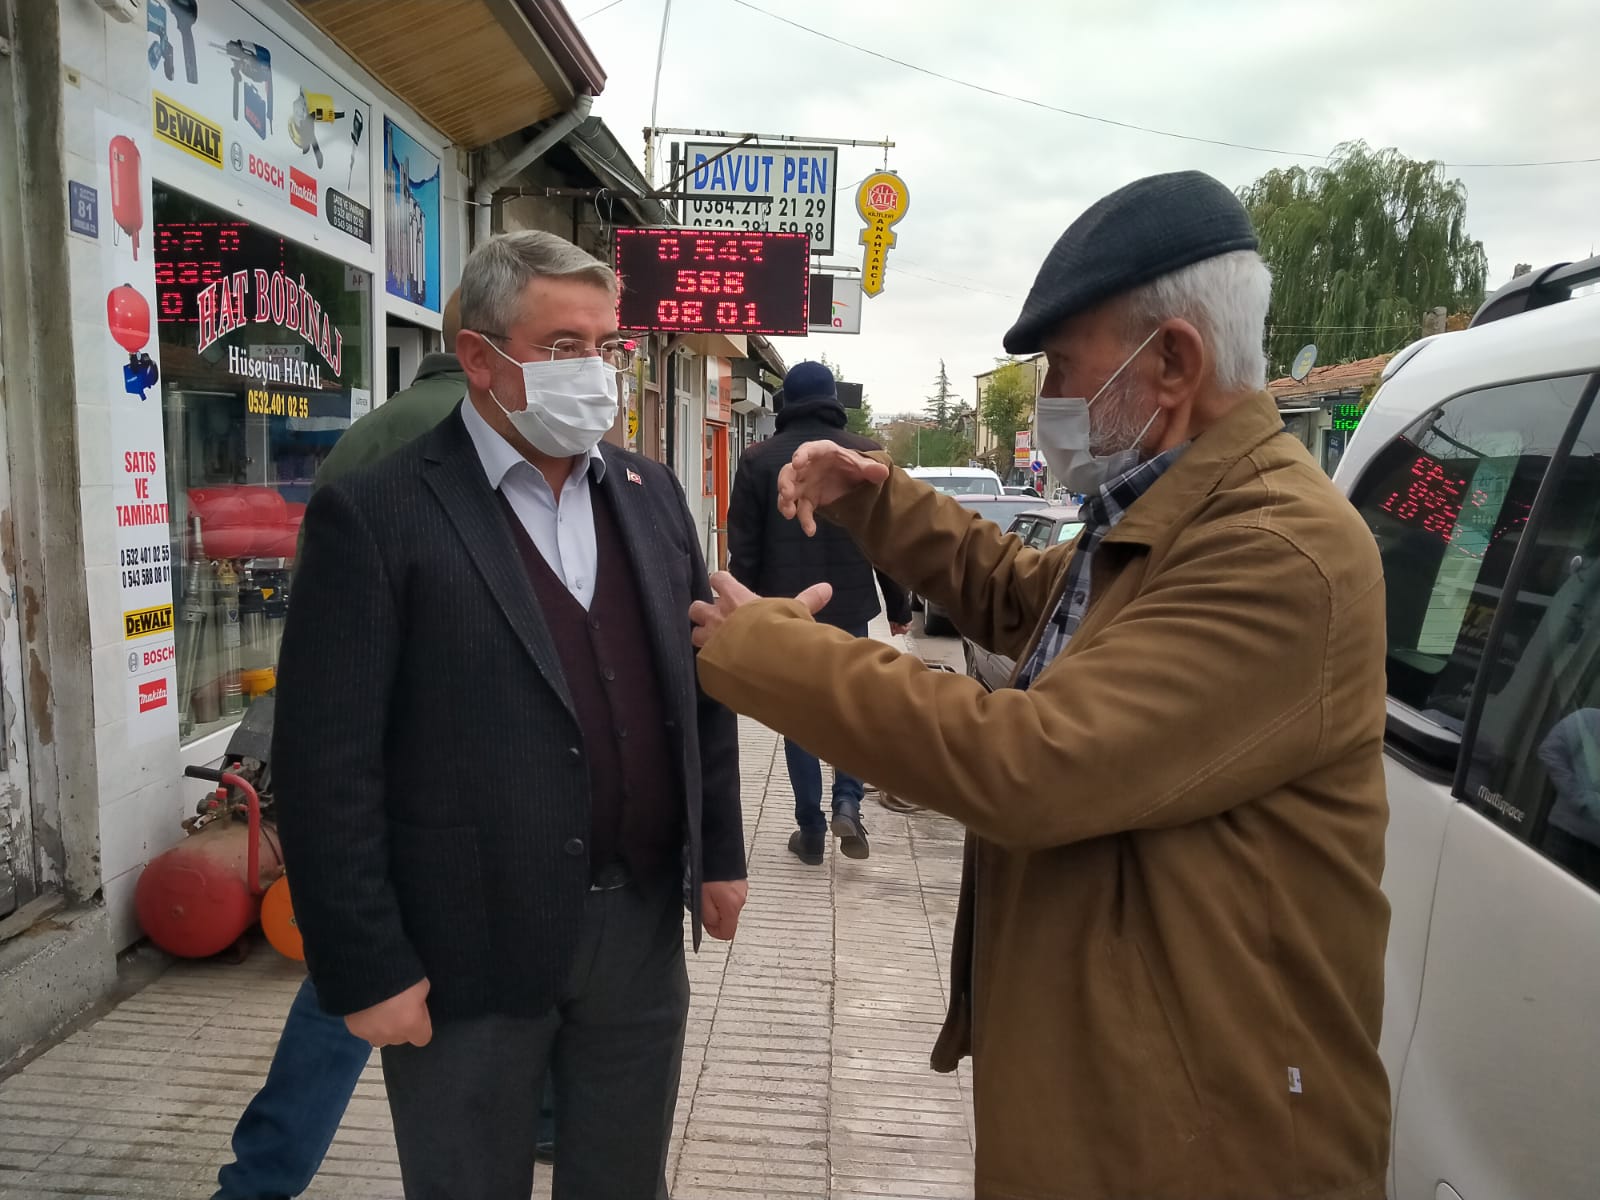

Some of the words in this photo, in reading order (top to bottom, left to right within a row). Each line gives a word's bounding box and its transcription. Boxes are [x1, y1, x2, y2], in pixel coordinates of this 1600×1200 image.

[249, 153, 285, 190] BOSCH
[694, 153, 774, 193] DAVUT
[783, 156, 828, 195] PEN
[78, 200, 93, 221] 81
[779, 197, 797, 217] 21
[804, 198, 826, 218] 29
[867, 187, 897, 210] KALE
[870, 218, 884, 286] ANAHTARCI
[675, 270, 745, 294] 588
[197, 269, 248, 355] HAT
[254, 268, 343, 378] BOBİNAJ
[657, 300, 703, 323] 08
[716, 301, 761, 325] 01
[228, 345, 280, 386] Hüseyin
[284, 357, 323, 390] HATAL
[287, 395, 297, 417] 02
[299, 397, 309, 419] 55
[125, 451, 156, 475] SATIŞ
[135, 478, 149, 499] VE
[121, 549, 125, 567] 0
[126, 548, 139, 566] 532
[140, 546, 151, 564] 401
[153, 545, 161, 562] 02
[161, 544, 169, 562] 55
[122, 571, 127, 588] 0
[128, 569, 140, 588] 543
[141, 567, 153, 586] 588
[154, 566, 162, 583] 08
[163, 565, 170, 582] 01
[143, 645, 175, 666] BOSCH
